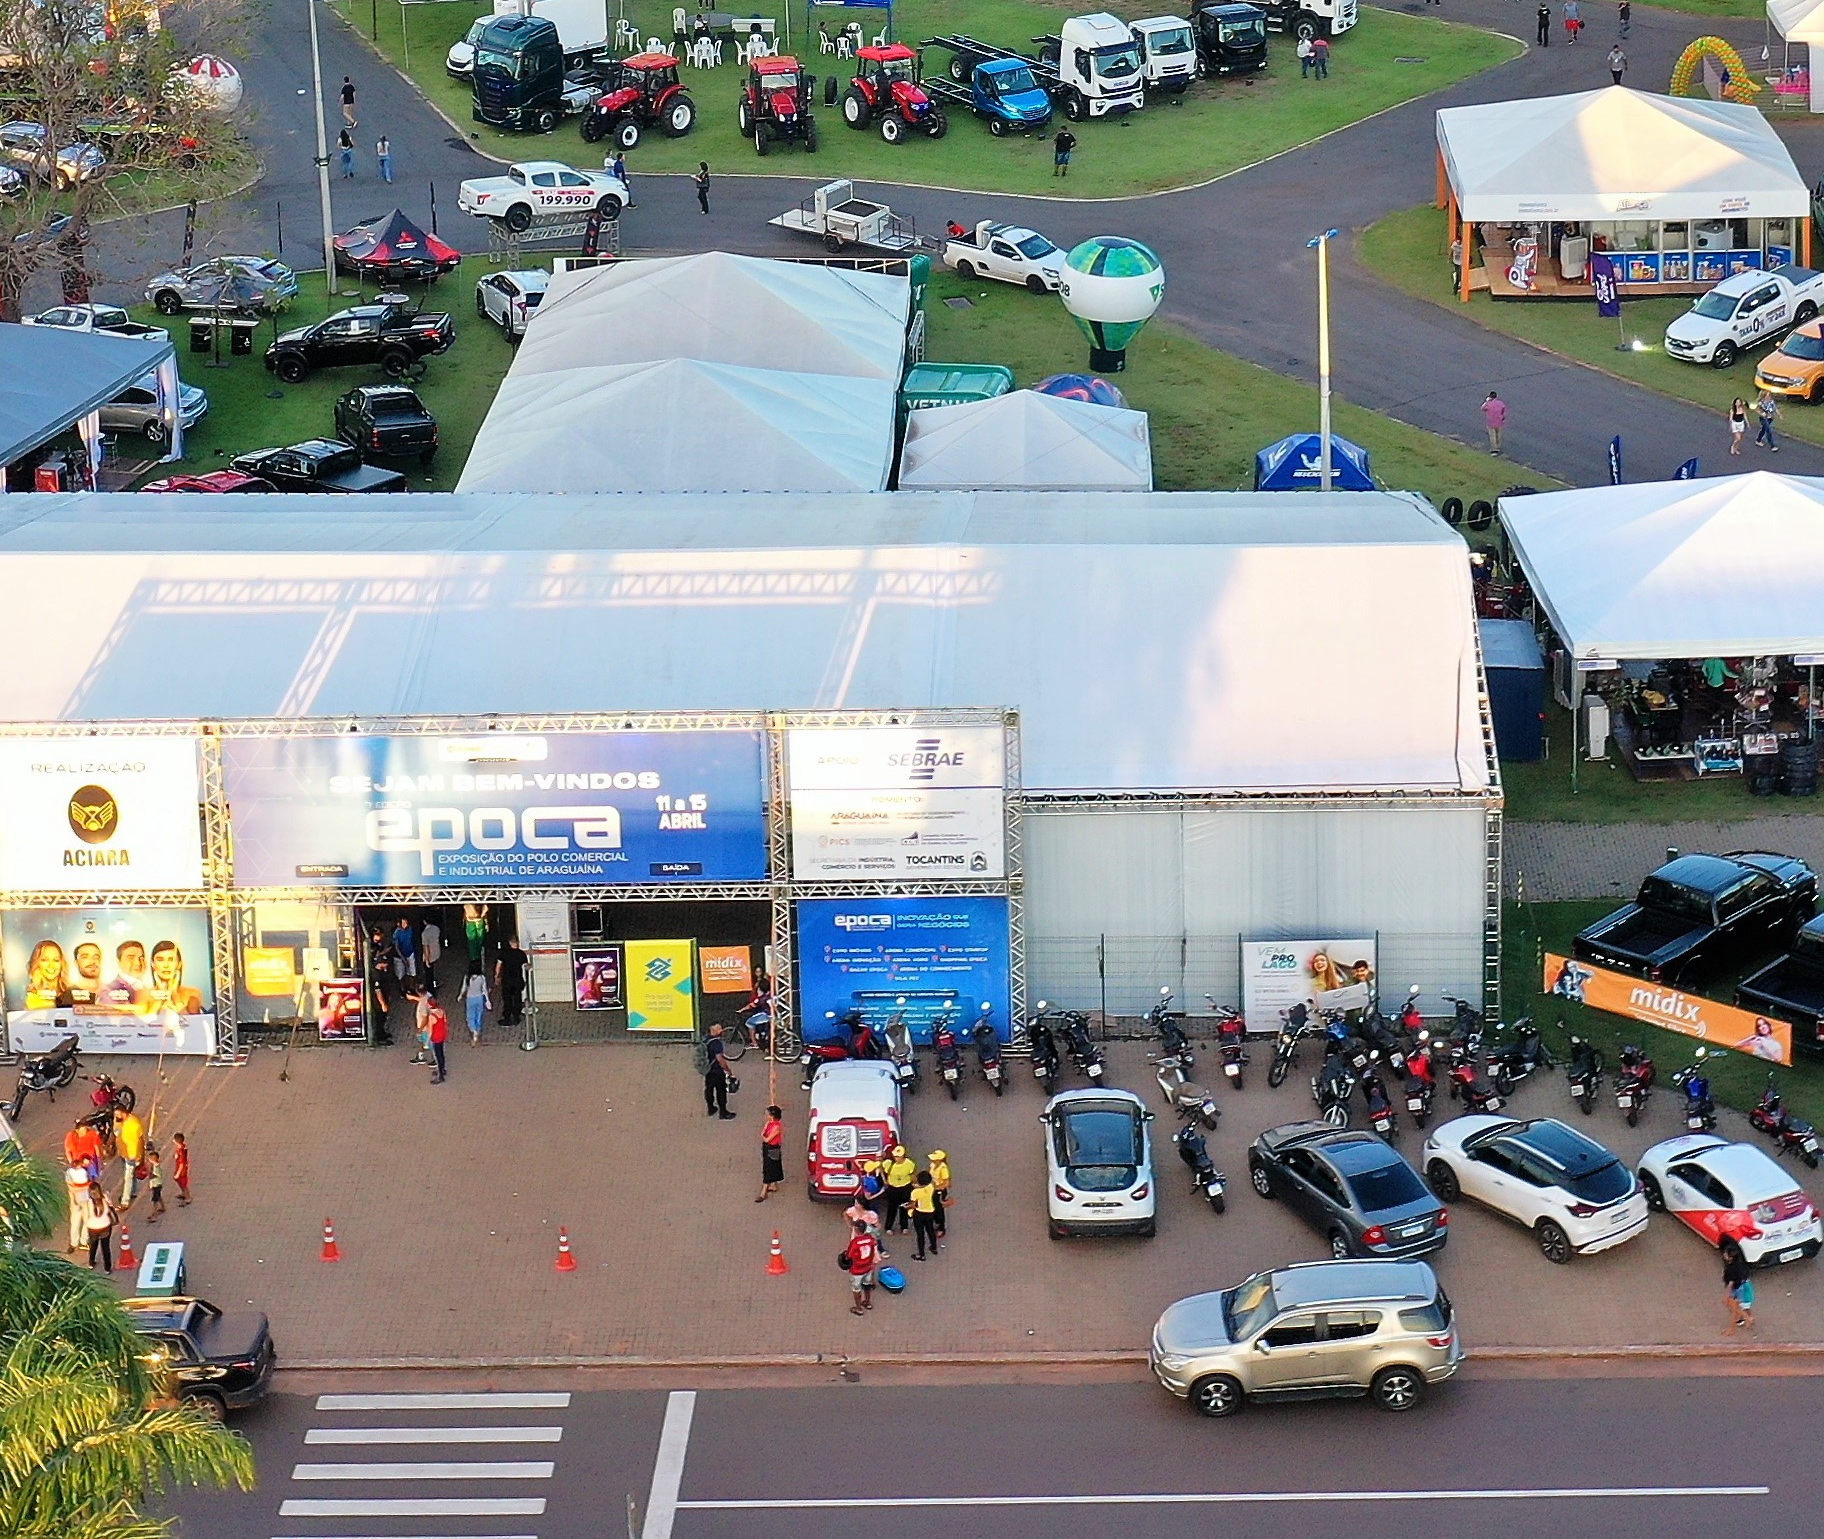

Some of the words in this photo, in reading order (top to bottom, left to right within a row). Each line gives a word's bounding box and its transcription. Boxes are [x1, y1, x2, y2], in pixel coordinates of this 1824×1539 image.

[540, 196, 591, 205] 199.990
[887, 752, 964, 766] SEBRAE
[30, 761, 146, 776] REALIZAÇÃO
[329, 775, 444, 793] SEJAM
[453, 772, 660, 792] BEM-VINDOS
[656, 796, 670, 811] 11
[689, 794, 707, 811] 15
[658, 813, 707, 830] ABRIL
[63, 849, 131, 867] ACIARA
[438, 853, 504, 865] EXPOSIÇÃO
[507, 853, 524, 863] DO
[528, 852, 559, 863] POLO
[561, 851, 628, 863] COMERCIAL
[906, 856, 965, 864] TOCANTINS
[301, 865, 343, 873] ENTRADA
[439, 867, 446, 876] E
[449, 866, 516, 876] INDUSTRIAL
[519, 866, 535, 875] DE
[537, 863, 603, 875] ARAGUAÍNA
[834, 914, 892, 931] epoca
[896, 913, 950, 921] INOVAÇÃO
[1258, 947, 1285, 956] VEM
[705, 956, 744, 969] midix
[1262, 960, 1297, 969] LAGO
[1630, 986, 1701, 1022] midix
